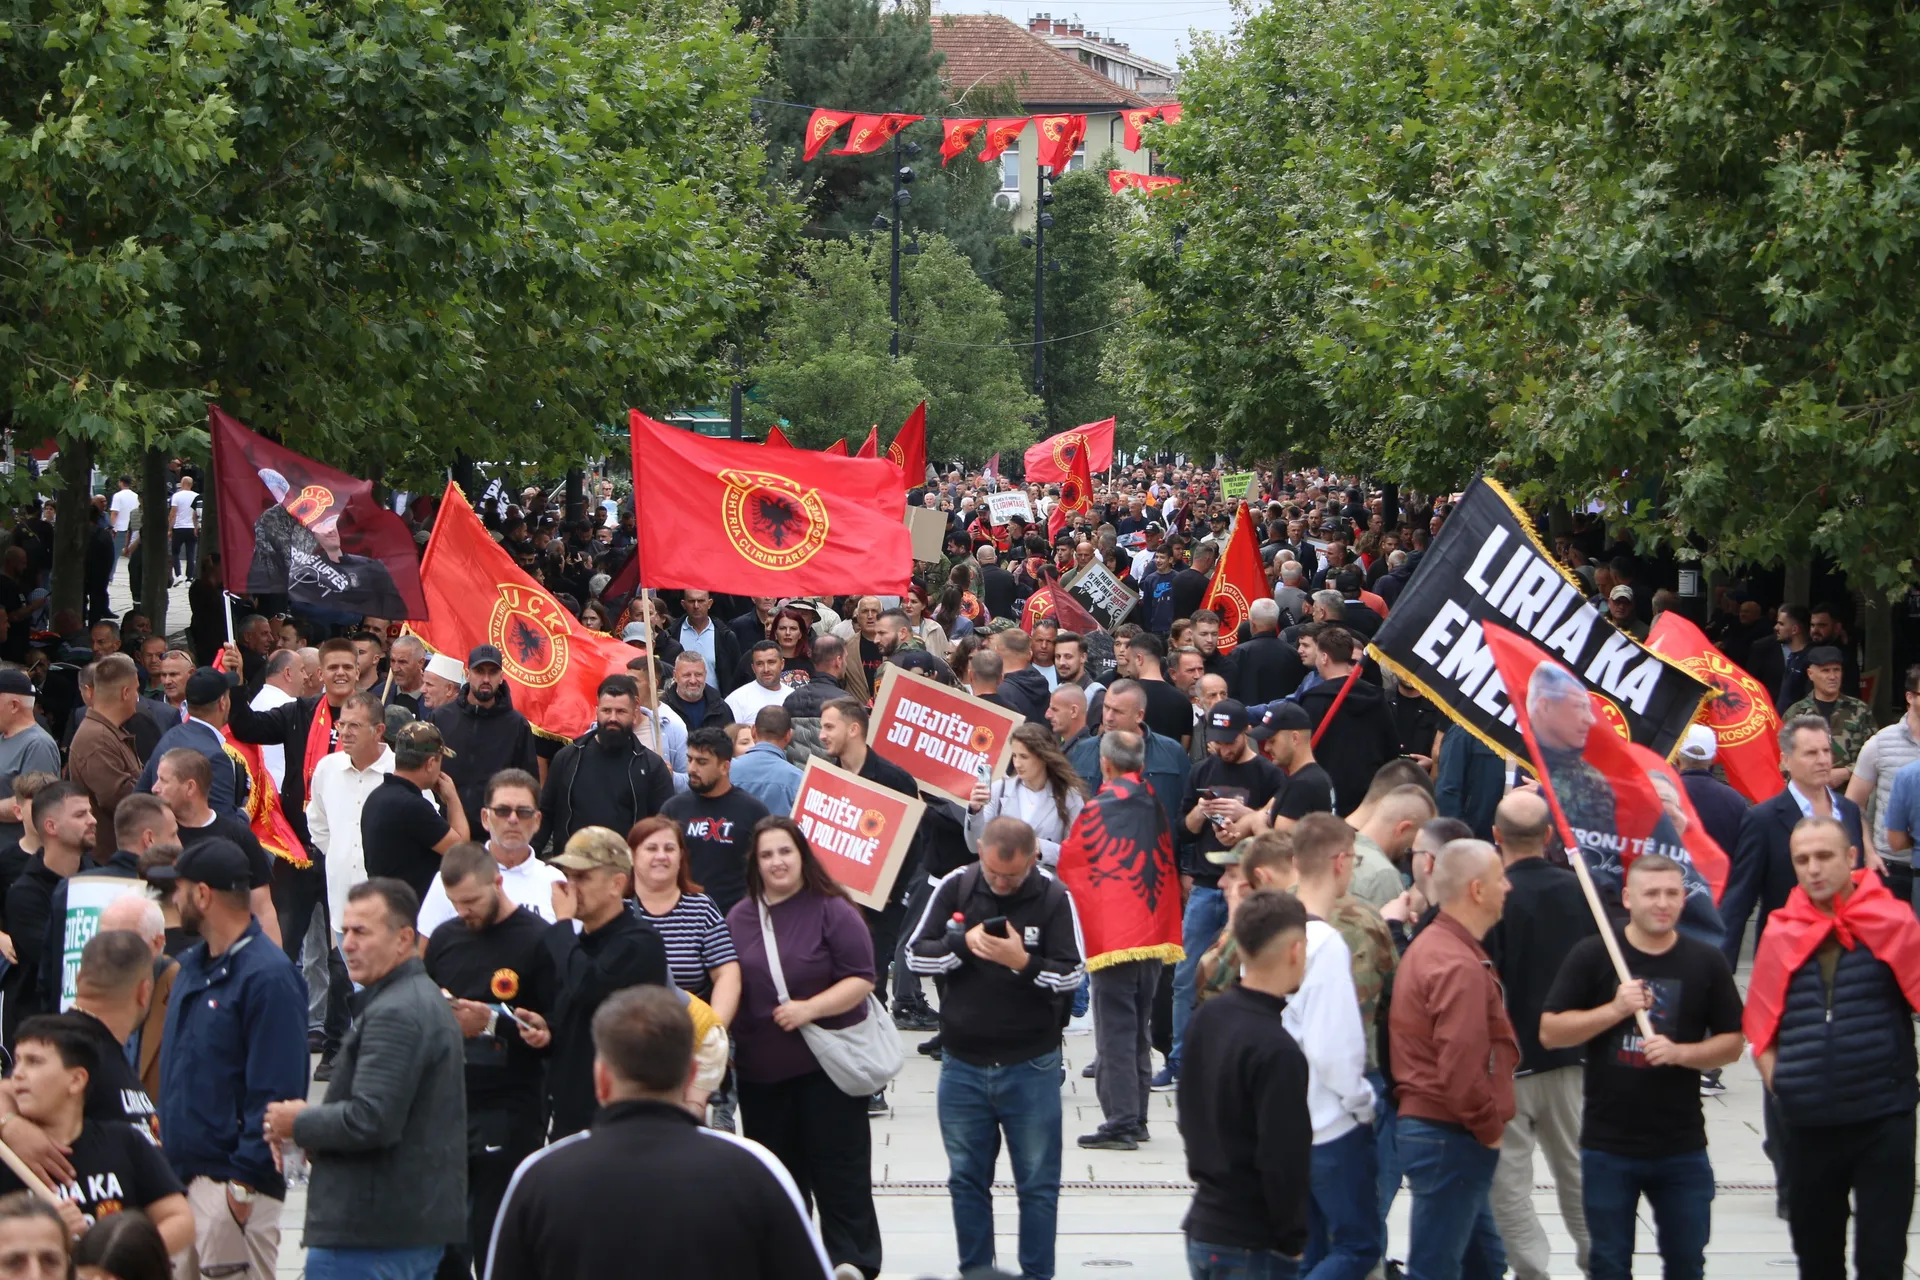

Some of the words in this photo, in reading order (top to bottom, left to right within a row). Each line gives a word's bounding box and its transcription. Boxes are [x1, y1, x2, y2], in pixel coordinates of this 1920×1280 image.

[1087, 571, 1095, 580] IS
[1092, 577, 1102, 587] THE
[1099, 586, 1113, 598] ONLY
[1098, 571, 1112, 587] THEIR
[1463, 524, 1600, 666] LIRIA
[1584, 629, 1663, 717] KA
[886, 721, 914, 748] JO
[895, 697, 974, 746] DREJTËSI
[803, 787, 863, 831] DREJTËSI
[686, 816, 734, 841] NEXT
[811, 820, 880, 866] POLITIKË
[87, 1172, 124, 1202] KA
